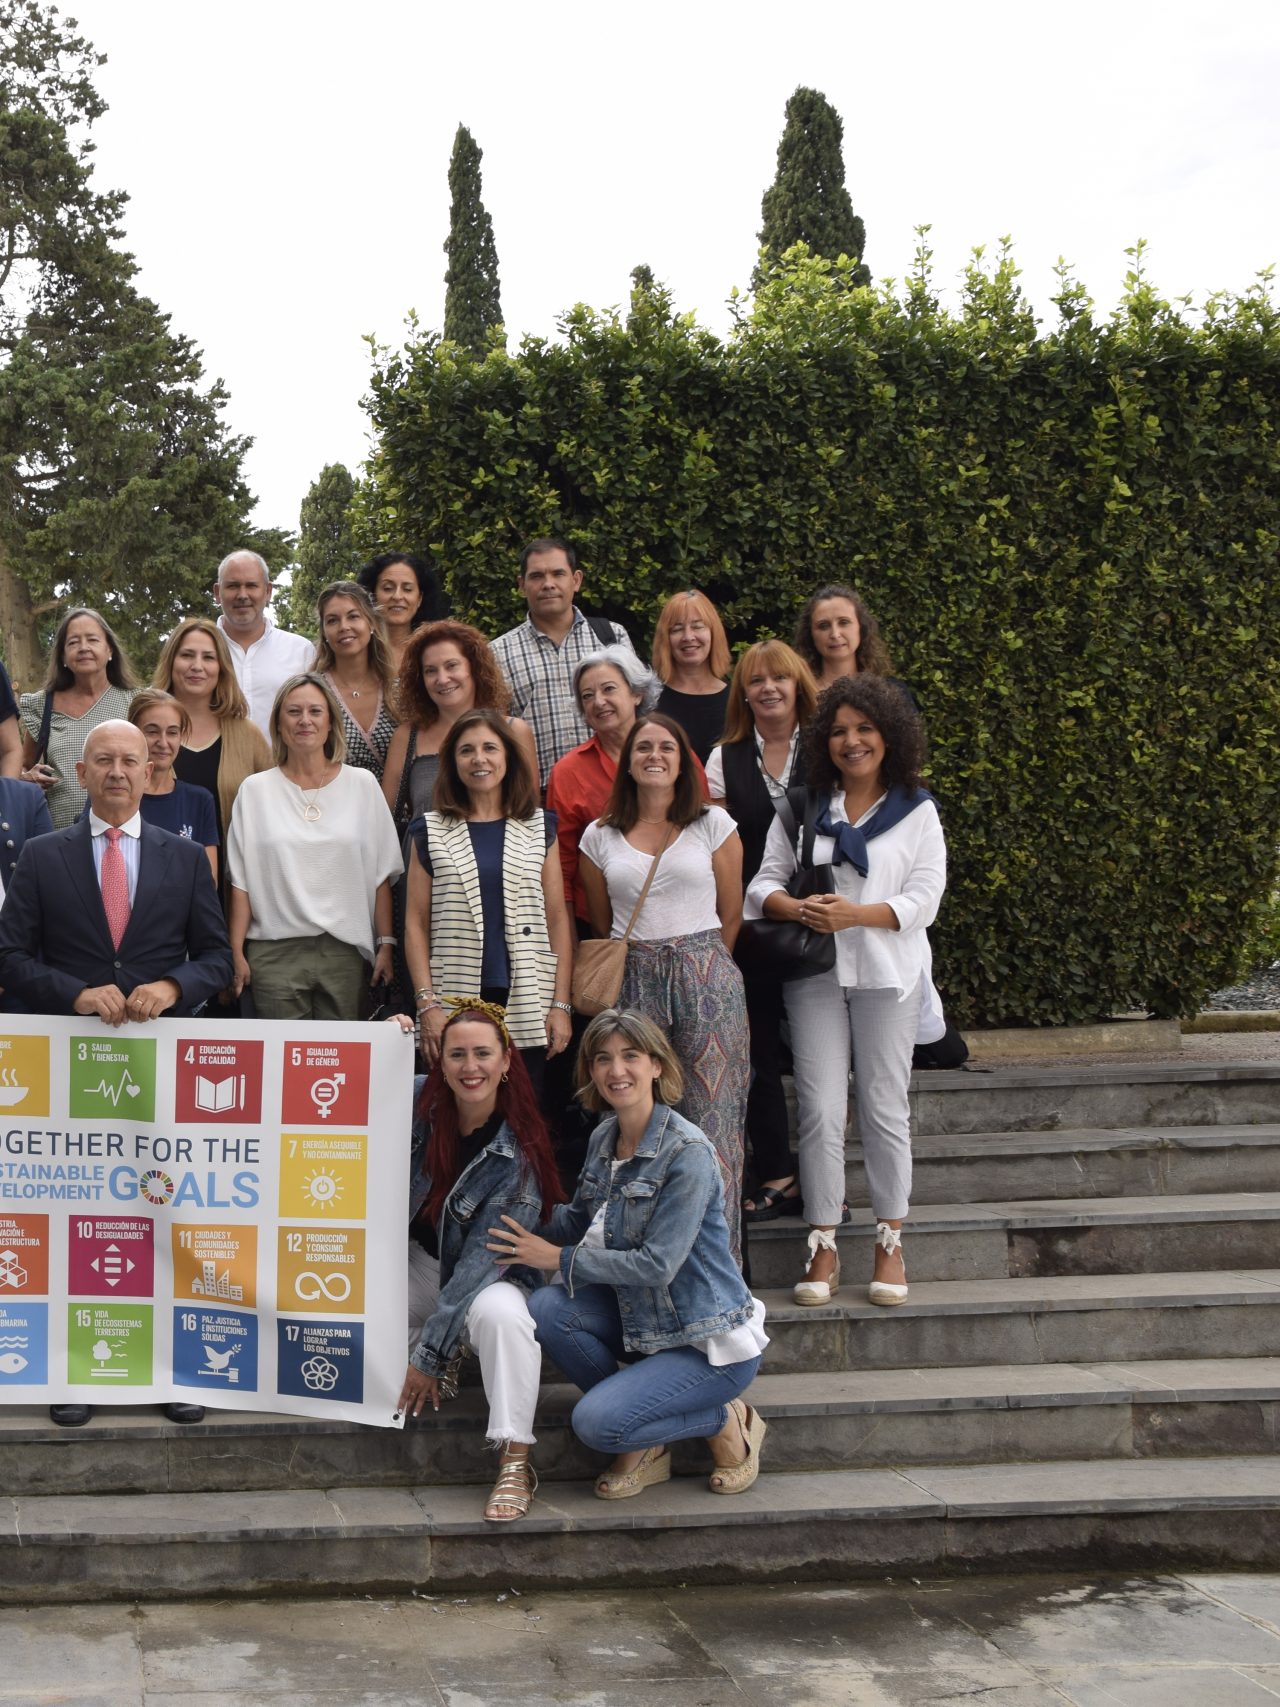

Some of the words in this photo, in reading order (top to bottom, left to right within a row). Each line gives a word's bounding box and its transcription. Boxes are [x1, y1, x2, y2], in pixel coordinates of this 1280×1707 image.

[78, 1043, 87, 1061] 3
[92, 1043, 111, 1052] SALUD
[199, 1045, 236, 1054] EDUCACIÓN
[307, 1048, 337, 1056] IGUALDAD
[92, 1053, 96, 1061] Y
[97, 1053, 129, 1062] BIENESTAR
[184, 1045, 195, 1064] 4
[292, 1048, 301, 1065] 5
[199, 1056, 207, 1064] DE
[209, 1056, 236, 1064] CALIDAD
[307, 1058, 314, 1066] DE
[315, 1057, 339, 1066] GÉNERO
[135, 1135, 193, 1163] FOR
[203, 1138, 260, 1163] THE
[289, 1140, 297, 1158] 7
[303, 1140, 328, 1149] ENERGÍA
[330, 1141, 361, 1150] ASEQUIBLE
[317, 1151, 361, 1160] CONTAMINANTE
[108, 1165, 260, 1209] GOALS
[77, 1221, 92, 1238] 10
[96, 1221, 130, 1231] REDUCCIÓN
[130, 1223, 138, 1231] DE
[138, 1223, 150, 1231] LAS
[21, 1229, 24, 1237] E
[96, 1231, 144, 1240] DESIGUALDADES
[195, 1231, 225, 1239] CIUDADES
[227, 1231, 231, 1239] Y
[306, 1233, 348, 1243] PRODUCCIÓN
[179, 1230, 191, 1248] 11
[286, 1233, 302, 1252] 12
[195, 1241, 239, 1249] COMUNIDADES
[307, 1244, 311, 1252] Y
[312, 1244, 343, 1252] CONSUMO
[194, 1250, 235, 1259] SOSTENIBLES
[306, 1254, 355, 1263] RESPONSABLES
[76, 1309, 91, 1327] 15
[95, 1310, 108, 1318] VIDA
[95, 1319, 102, 1327] DE
[103, 1320, 142, 1328] ECOSISTEMAS
[181, 1313, 196, 1331] 16
[215, 1317, 241, 1327] JUSTICIA
[95, 1328, 130, 1336] TERRESTRES
[202, 1324, 205, 1332] E
[206, 1324, 247, 1336] INSTITUCIONES
[286, 1325, 300, 1341] 17
[304, 1328, 334, 1337] ALIANZAS
[334, 1329, 351, 1338] PARA
[201, 1332, 225, 1342] SÓLIDAS
[304, 1336, 327, 1345] LOGRAR
[316, 1345, 350, 1356] OBJETIVOS
